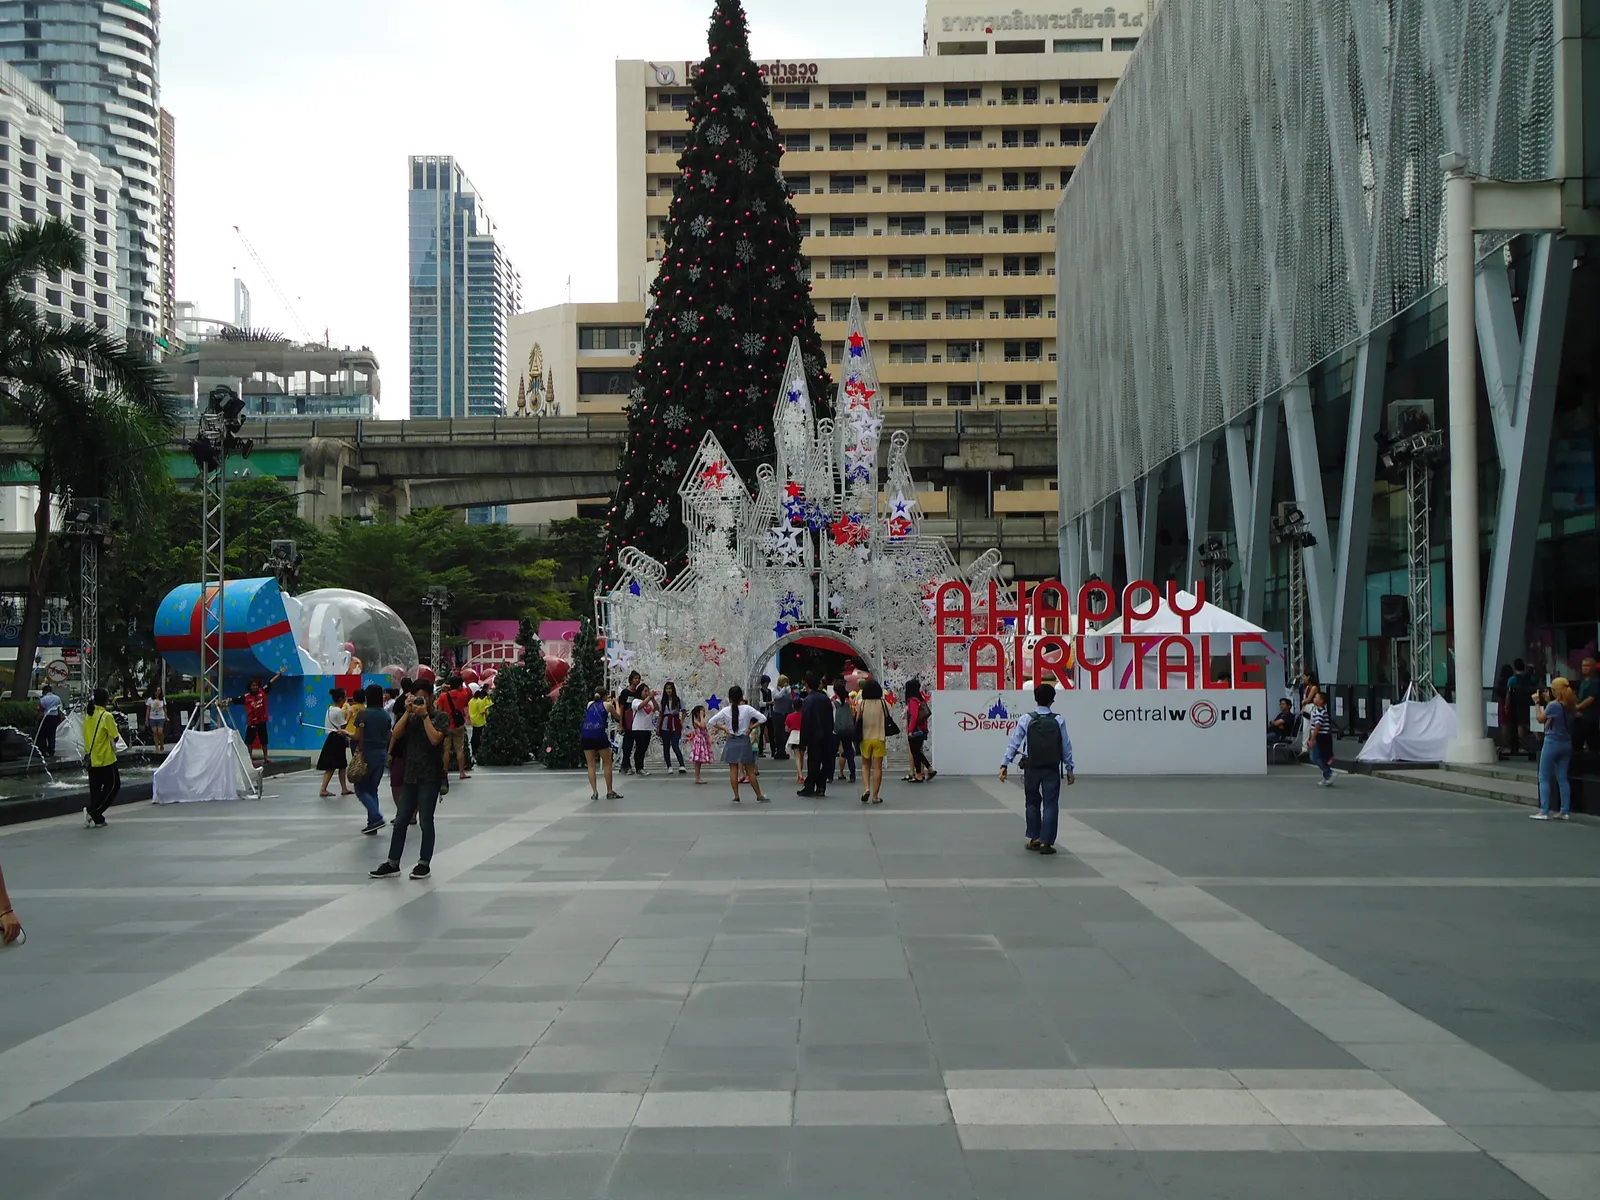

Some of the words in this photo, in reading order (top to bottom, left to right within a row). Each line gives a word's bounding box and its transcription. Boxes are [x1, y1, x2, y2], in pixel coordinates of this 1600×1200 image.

[942, 7, 1115, 32] อาคารเฉลิมพระเกียรติ
[772, 76, 818, 84] HOSPITAL
[936, 580, 972, 635] A
[988, 580, 1206, 636] HAPPY
